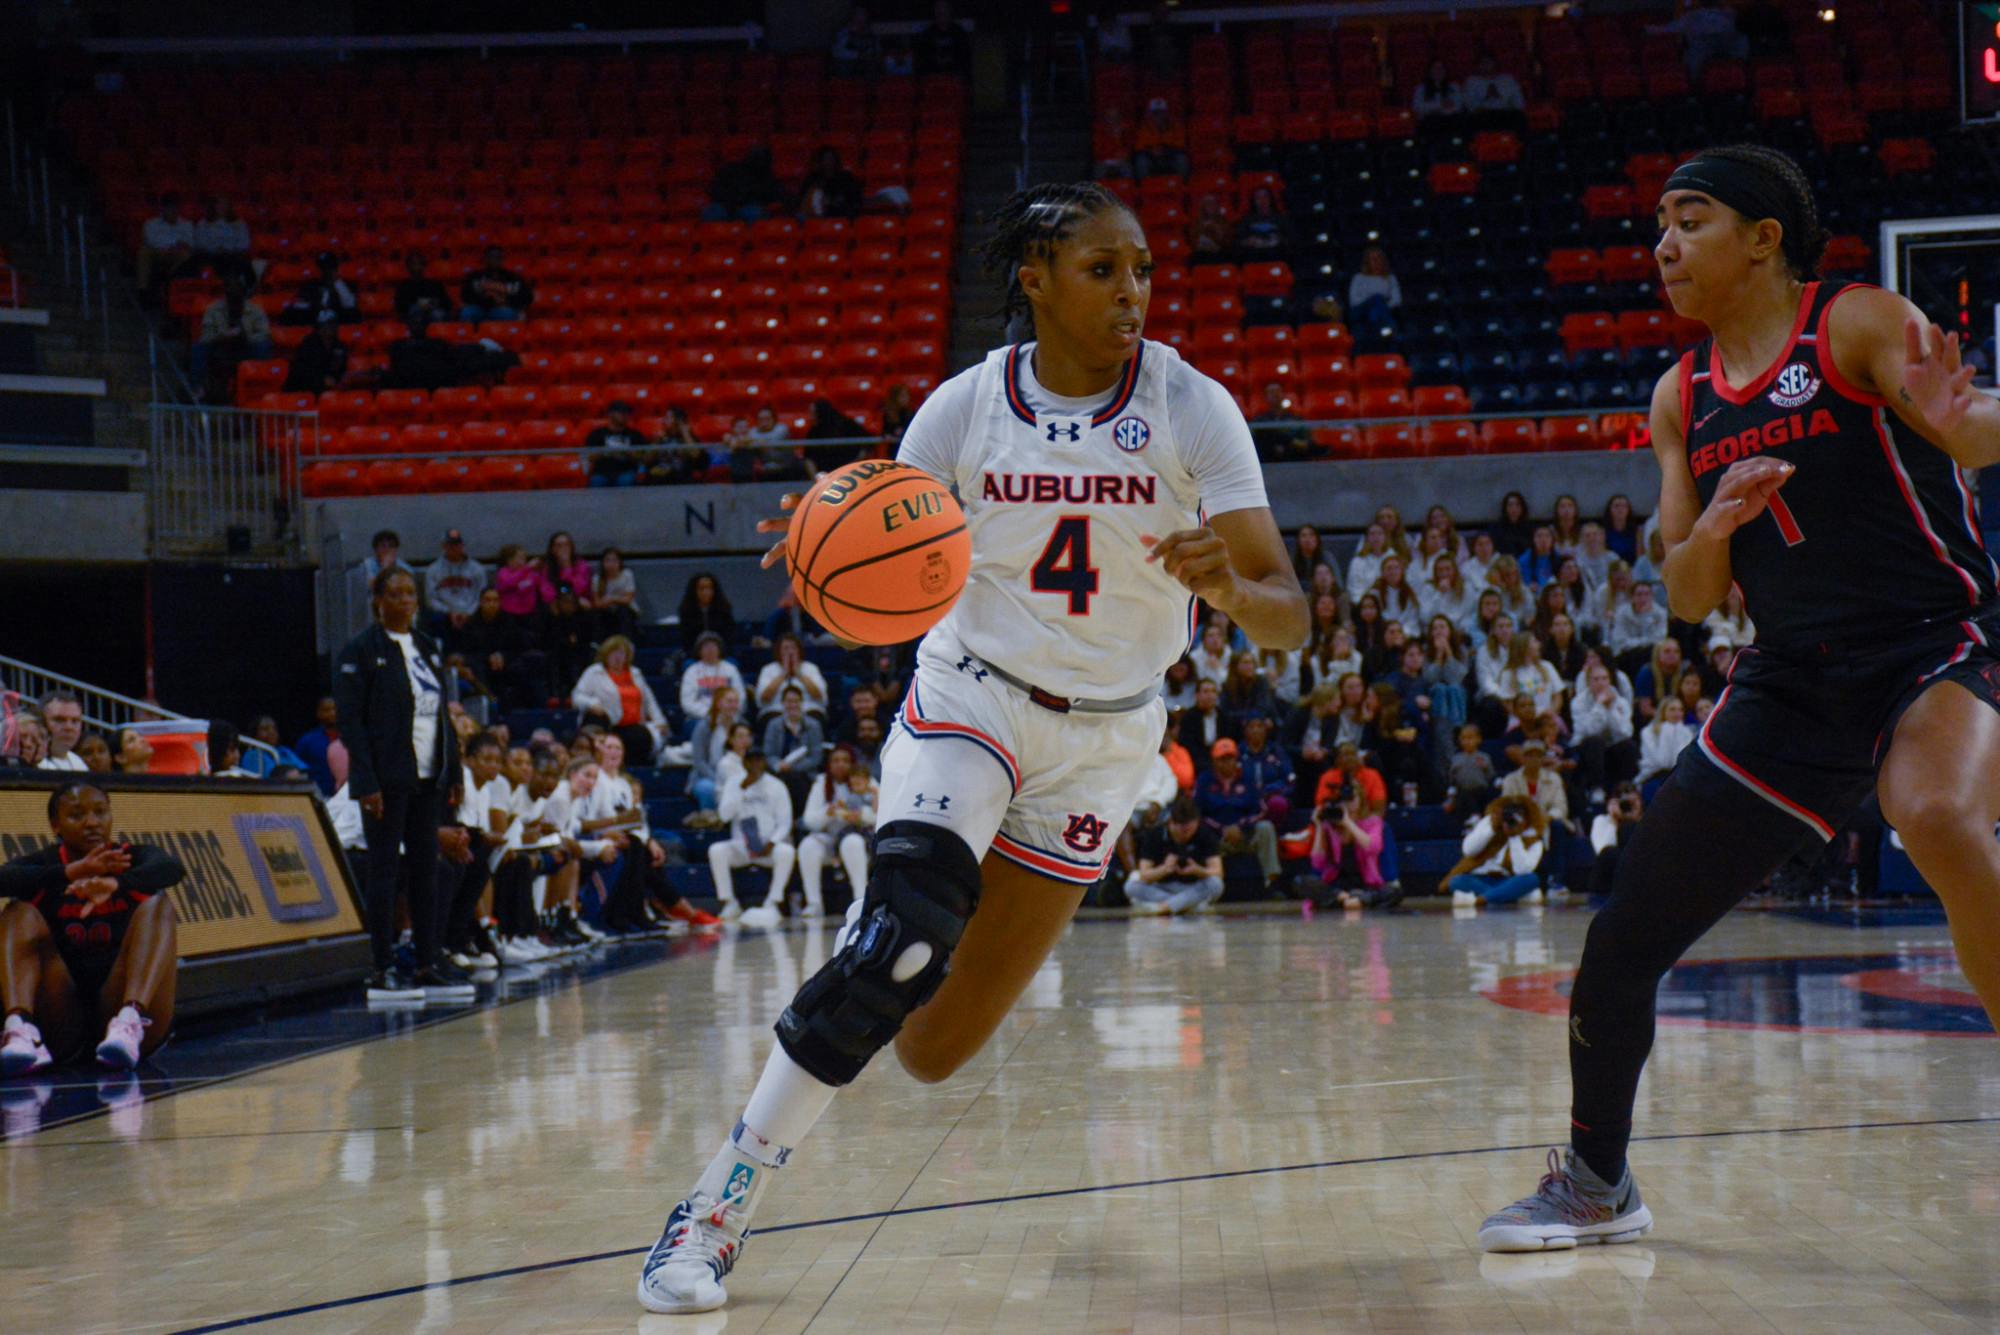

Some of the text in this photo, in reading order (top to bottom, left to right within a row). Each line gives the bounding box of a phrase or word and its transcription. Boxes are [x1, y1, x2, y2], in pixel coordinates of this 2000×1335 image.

[1778, 364, 1810, 396] SEC
[1116, 419, 1148, 450] SEC
[1690, 408, 1840, 479] GEORGIA
[983, 472, 1156, 504] AUBURN
[684, 500, 715, 537] N
[882, 491, 943, 532] EVO
[1030, 514, 1099, 616] 4
